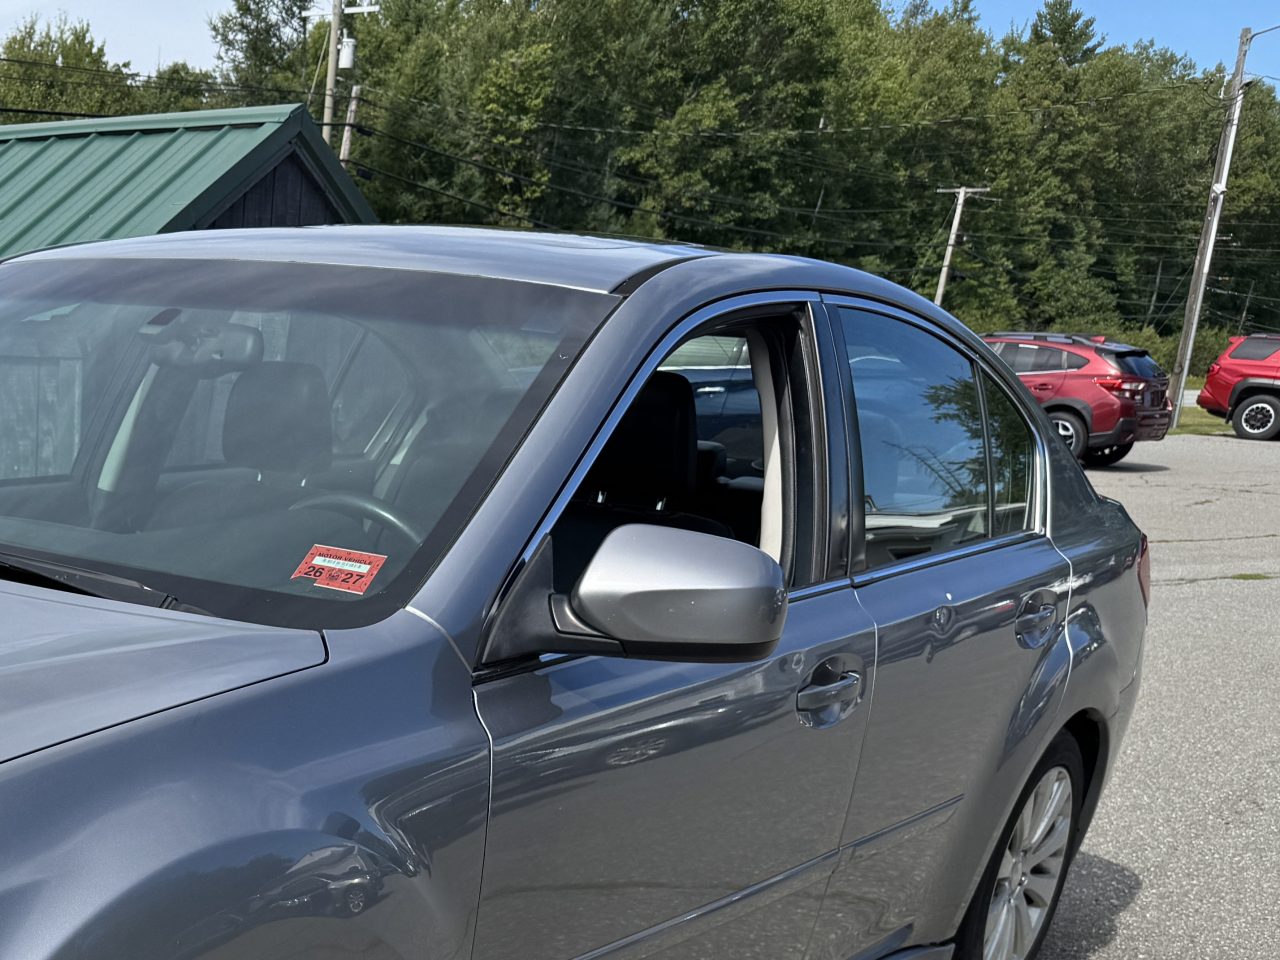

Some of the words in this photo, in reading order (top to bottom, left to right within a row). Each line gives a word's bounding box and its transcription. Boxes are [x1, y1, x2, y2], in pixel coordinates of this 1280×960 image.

[318, 552, 342, 560] MOTOR
[344, 557, 373, 566] VEHICLE
[304, 565, 325, 578] 26
[341, 572, 365, 584] 27
